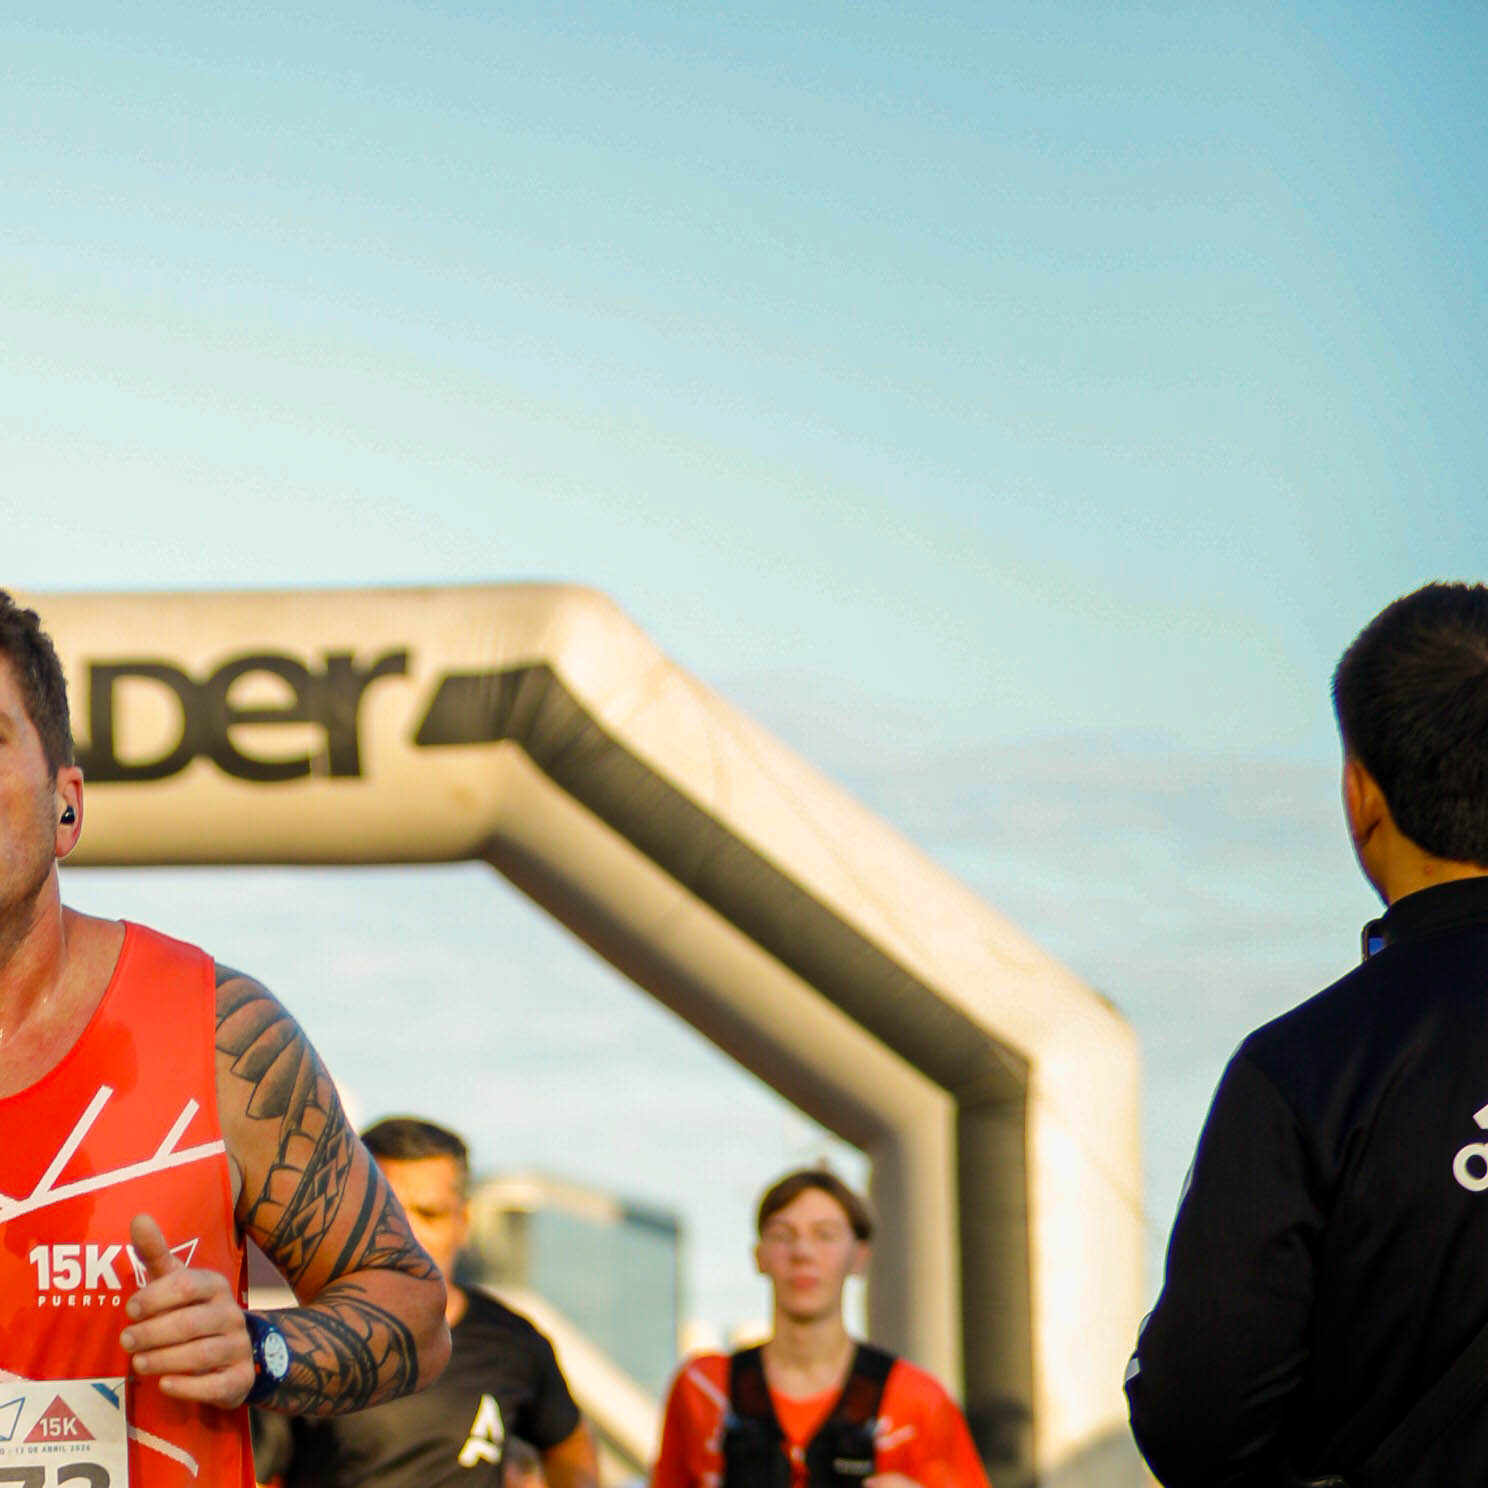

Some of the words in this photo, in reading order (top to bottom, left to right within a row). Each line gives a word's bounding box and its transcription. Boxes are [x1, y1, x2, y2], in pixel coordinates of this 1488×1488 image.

[29, 1244, 123, 1290] 15K
[38, 1295, 121, 1307] PUERTO
[39, 1416, 78, 1437] 15K
